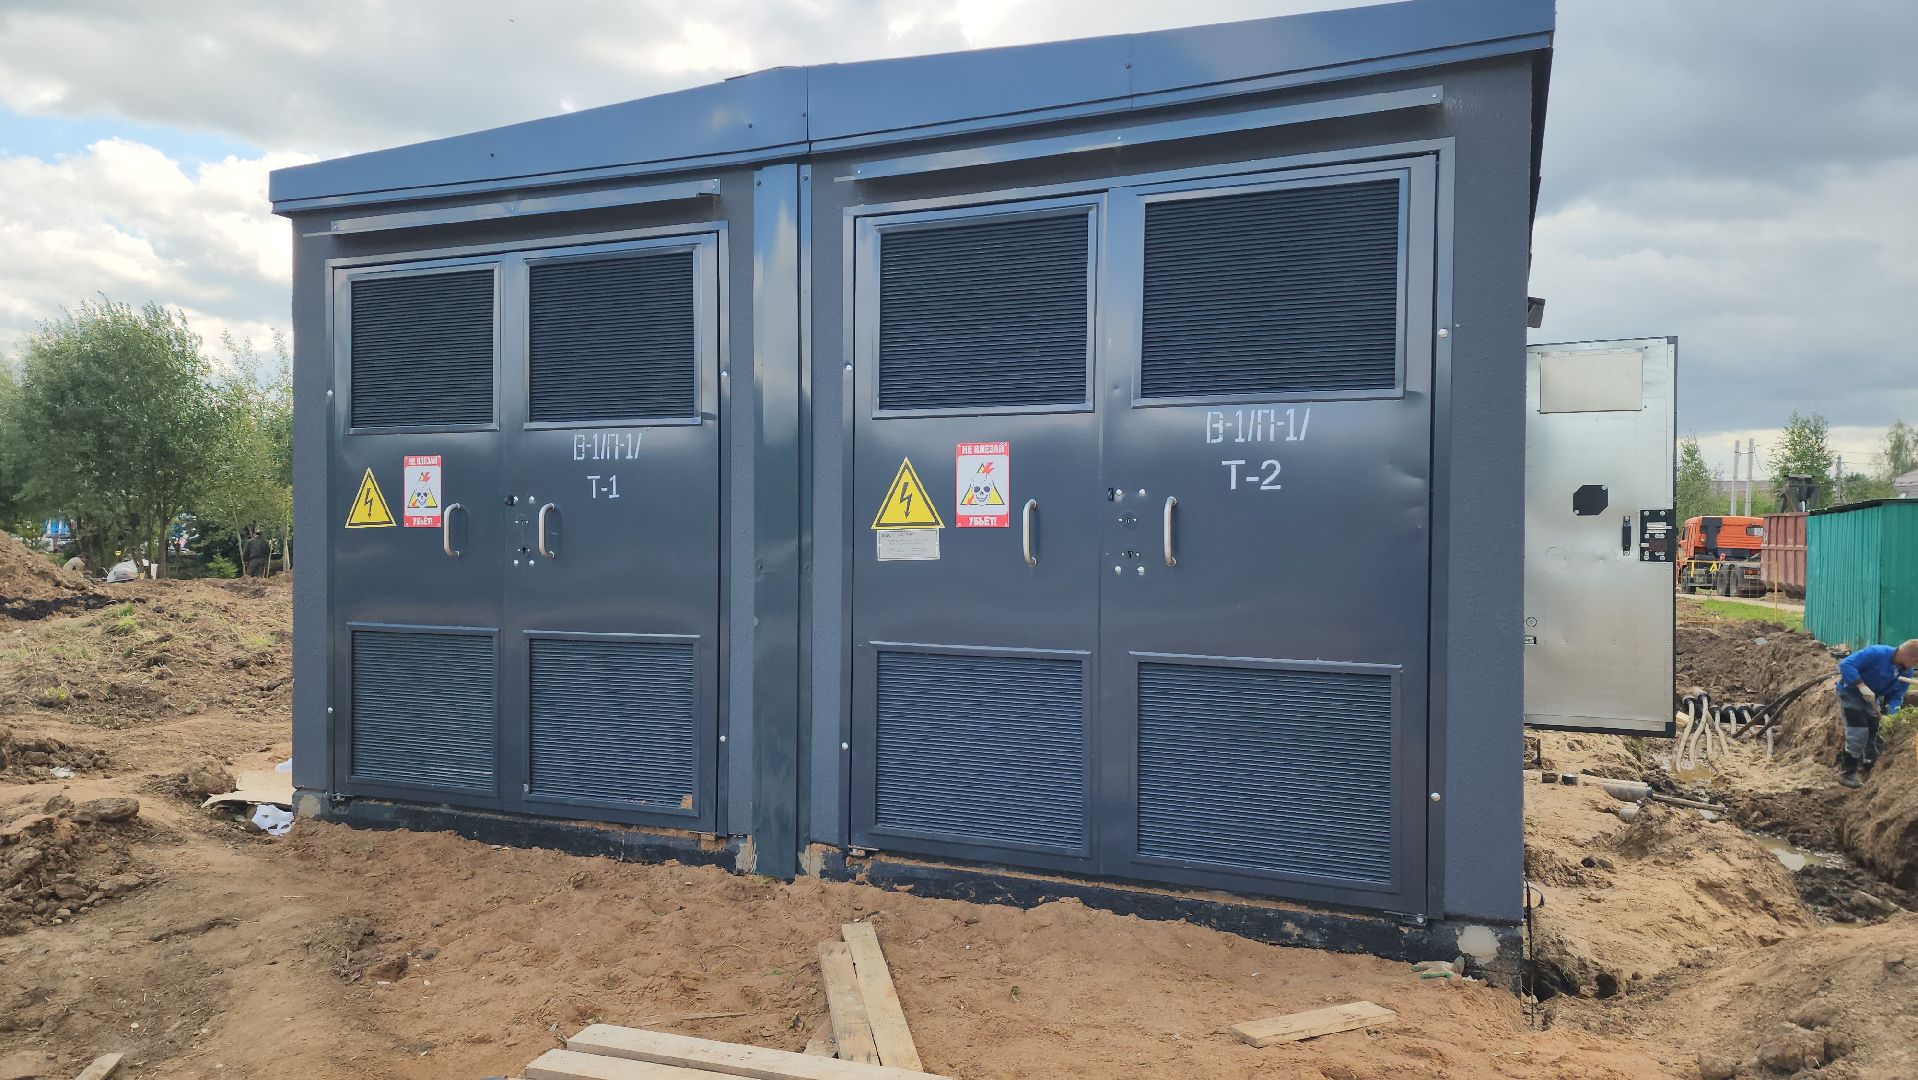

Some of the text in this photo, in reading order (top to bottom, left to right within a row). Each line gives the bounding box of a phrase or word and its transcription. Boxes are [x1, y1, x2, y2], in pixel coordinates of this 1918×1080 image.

[1207, 408, 1310, 443] В-1/П-1/
[574, 433, 642, 460] В-1/П-1/
[961, 444, 1005, 454] НЕ ВЛЕЗАЙ
[587, 475, 620, 499] Т-1
[1222, 459, 1281, 490] Т-2
